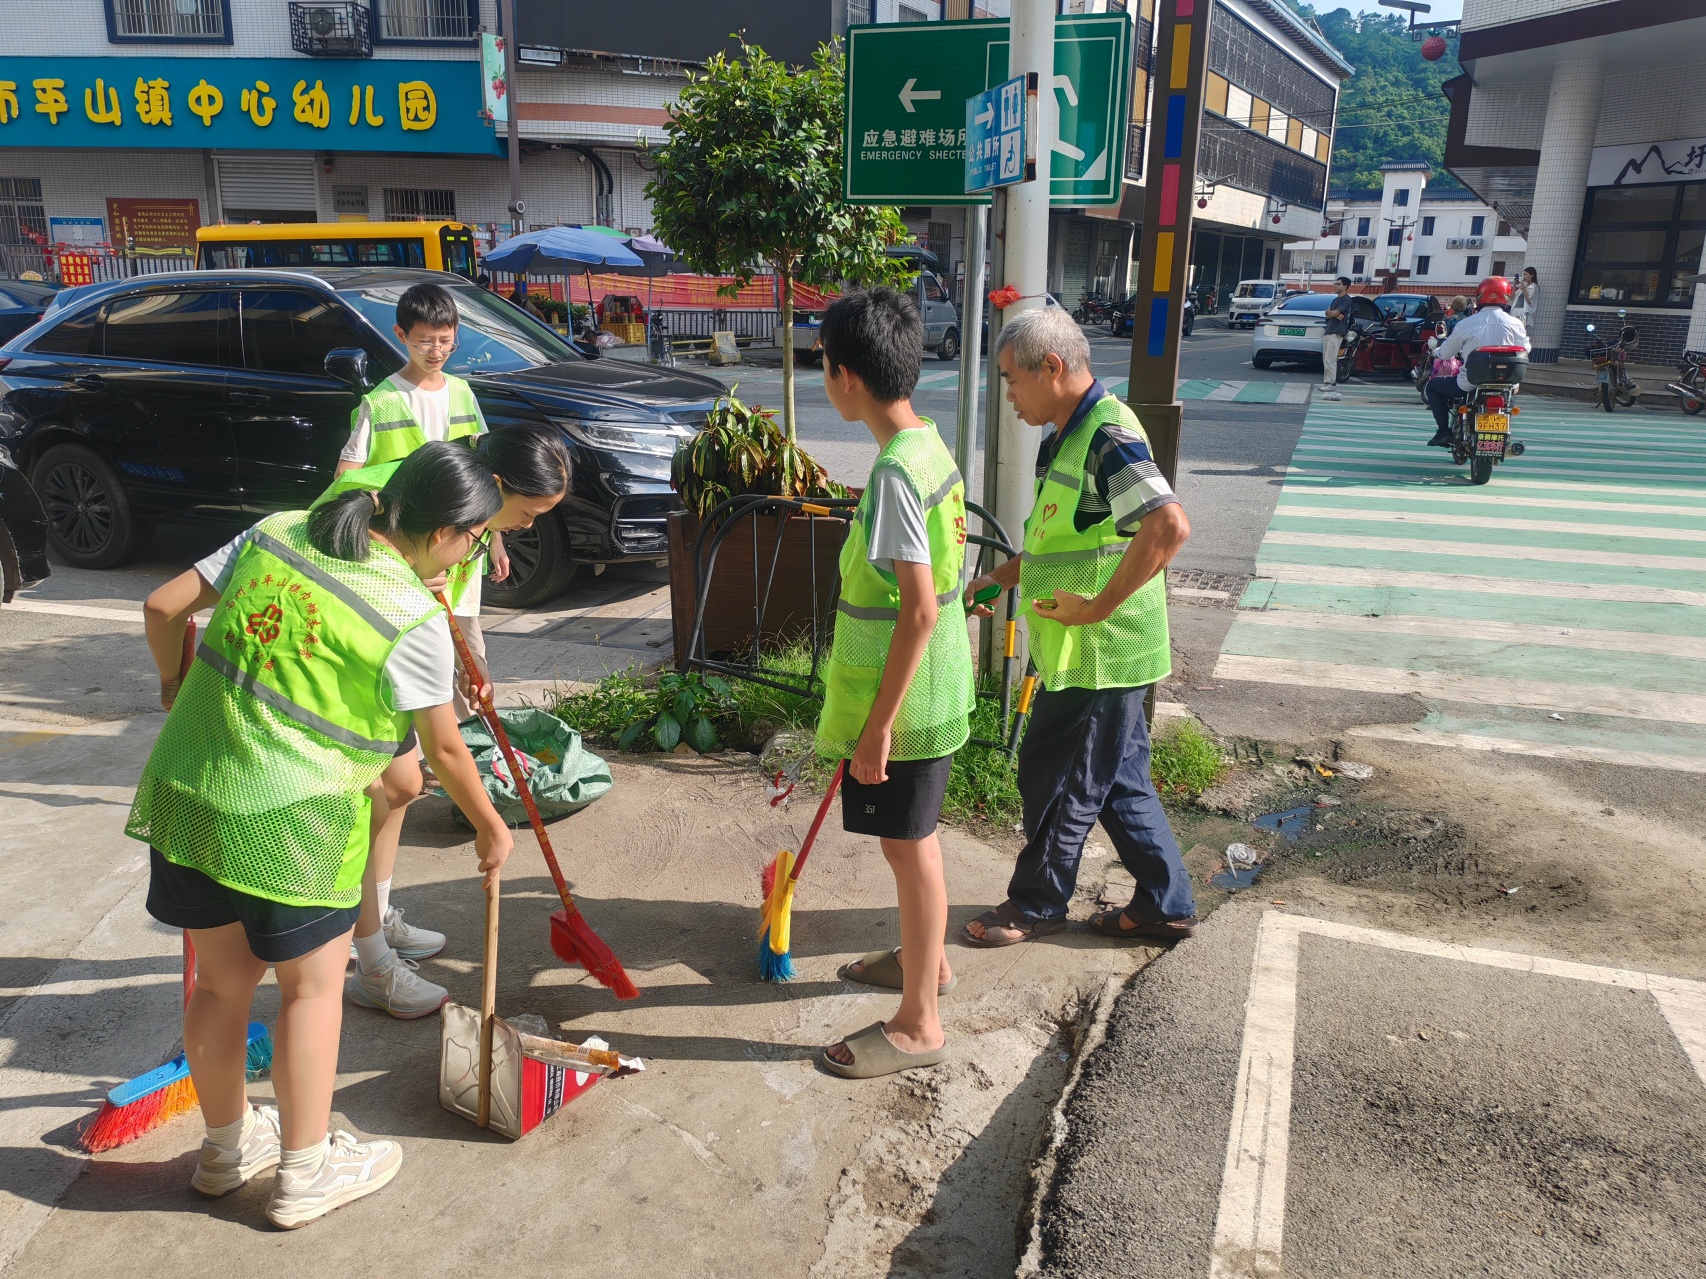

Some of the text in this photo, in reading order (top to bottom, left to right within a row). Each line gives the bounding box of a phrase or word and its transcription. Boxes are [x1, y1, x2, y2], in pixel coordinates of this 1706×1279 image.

[0, 77, 437, 130] 市平山镇中心幼儿园
[862, 129, 966, 148] 应急避难场所
[860, 151, 966, 161] EMERGENCY SHECTE
[968, 135, 1000, 163] 公共厕所
[1477, 422, 1506, 430] 9FH37
